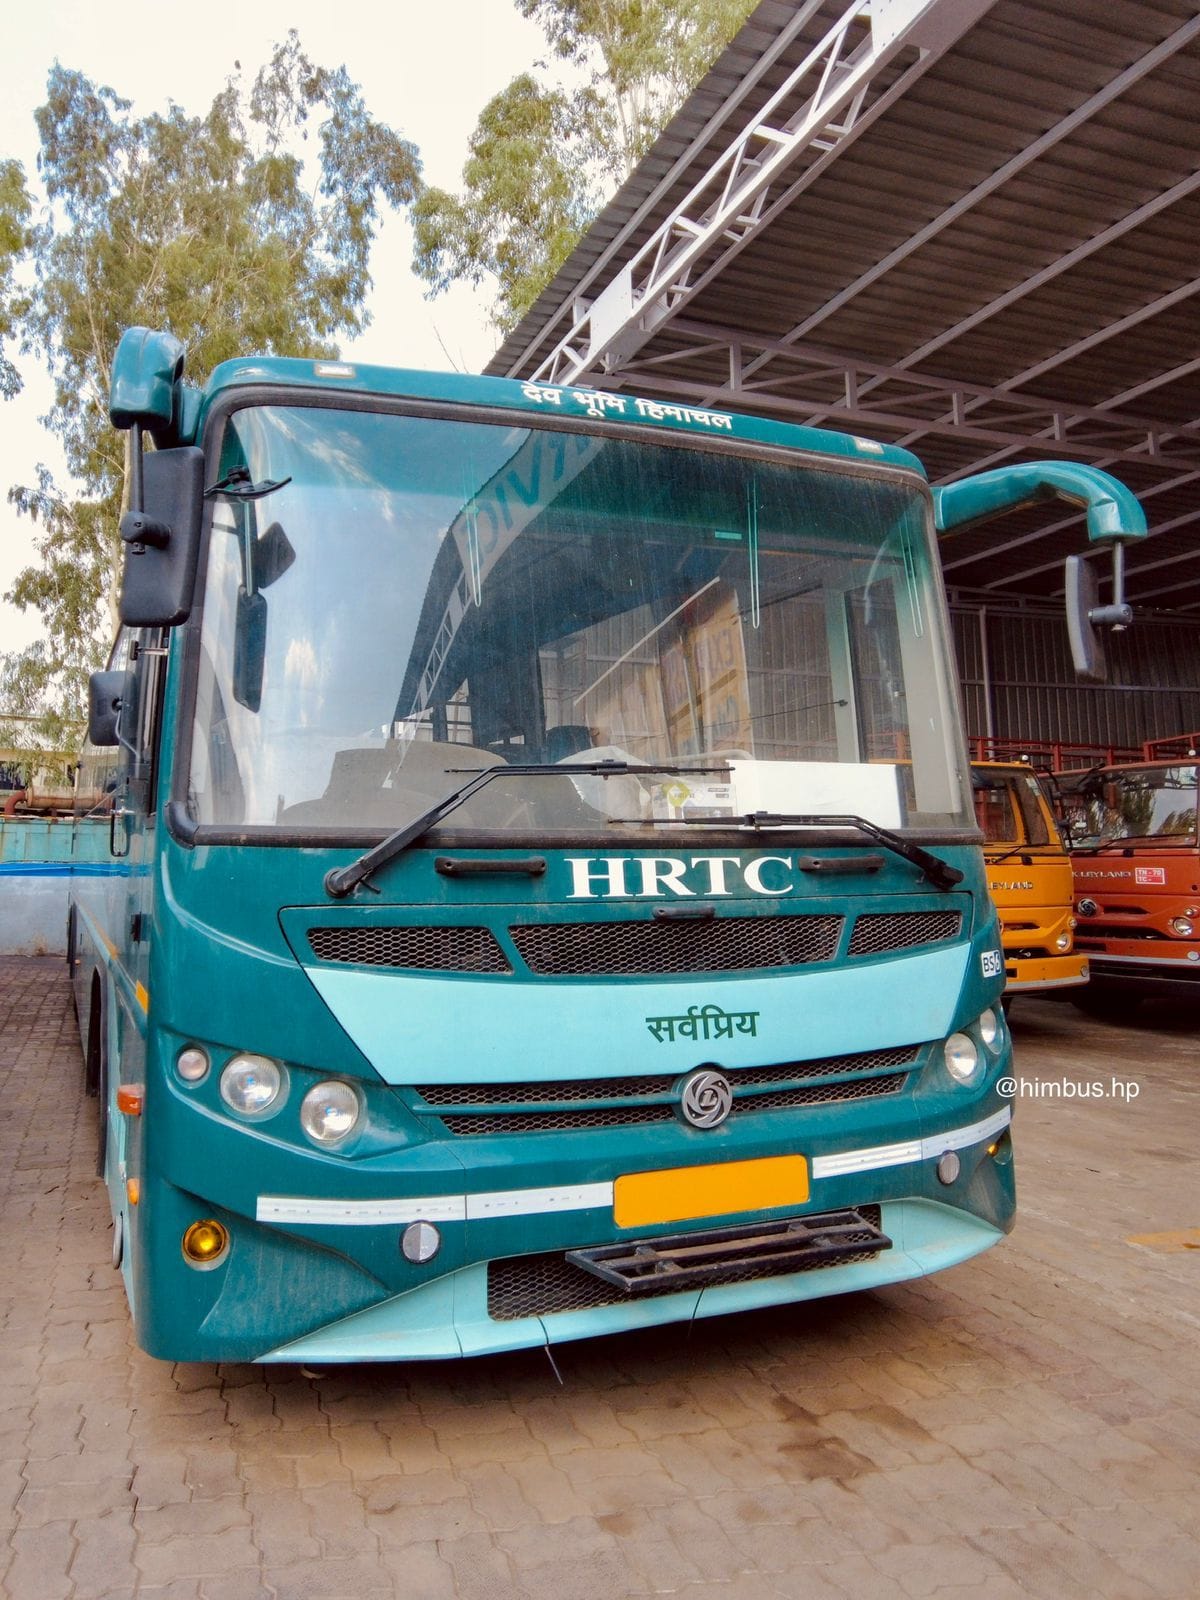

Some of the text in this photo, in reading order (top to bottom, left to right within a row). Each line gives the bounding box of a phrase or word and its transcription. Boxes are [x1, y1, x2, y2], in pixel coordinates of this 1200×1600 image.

[520, 382, 732, 430] देव भूमि हिमाचल
[564, 856, 794, 899] HRTC
[645, 1004, 760, 1043] सर्वप्रिय
